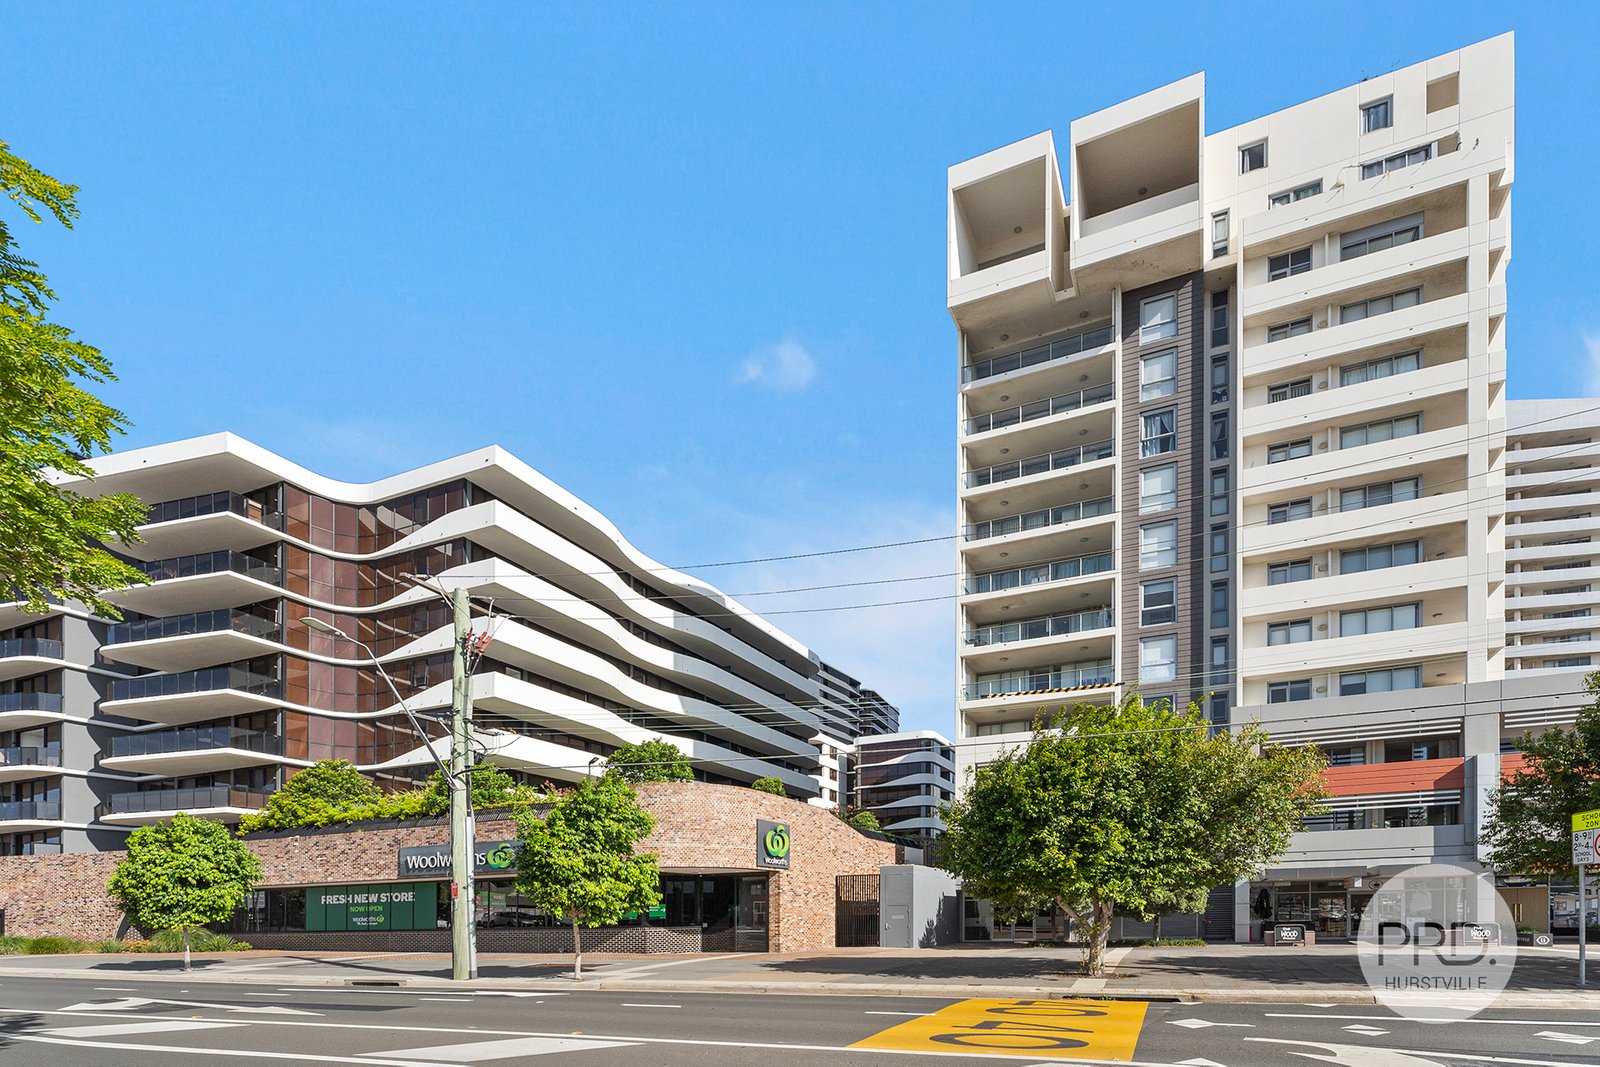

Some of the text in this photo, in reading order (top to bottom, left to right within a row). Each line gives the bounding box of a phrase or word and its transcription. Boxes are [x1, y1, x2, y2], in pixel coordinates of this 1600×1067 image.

[1582, 813, 1600, 821] SCHO
[406, 852, 486, 869] woolws
[321, 894, 352, 905] FRESH
[354, 893, 378, 904] NEW
[1280, 929, 1299, 938] WOOD
[1470, 929, 1491, 937] WOOD
